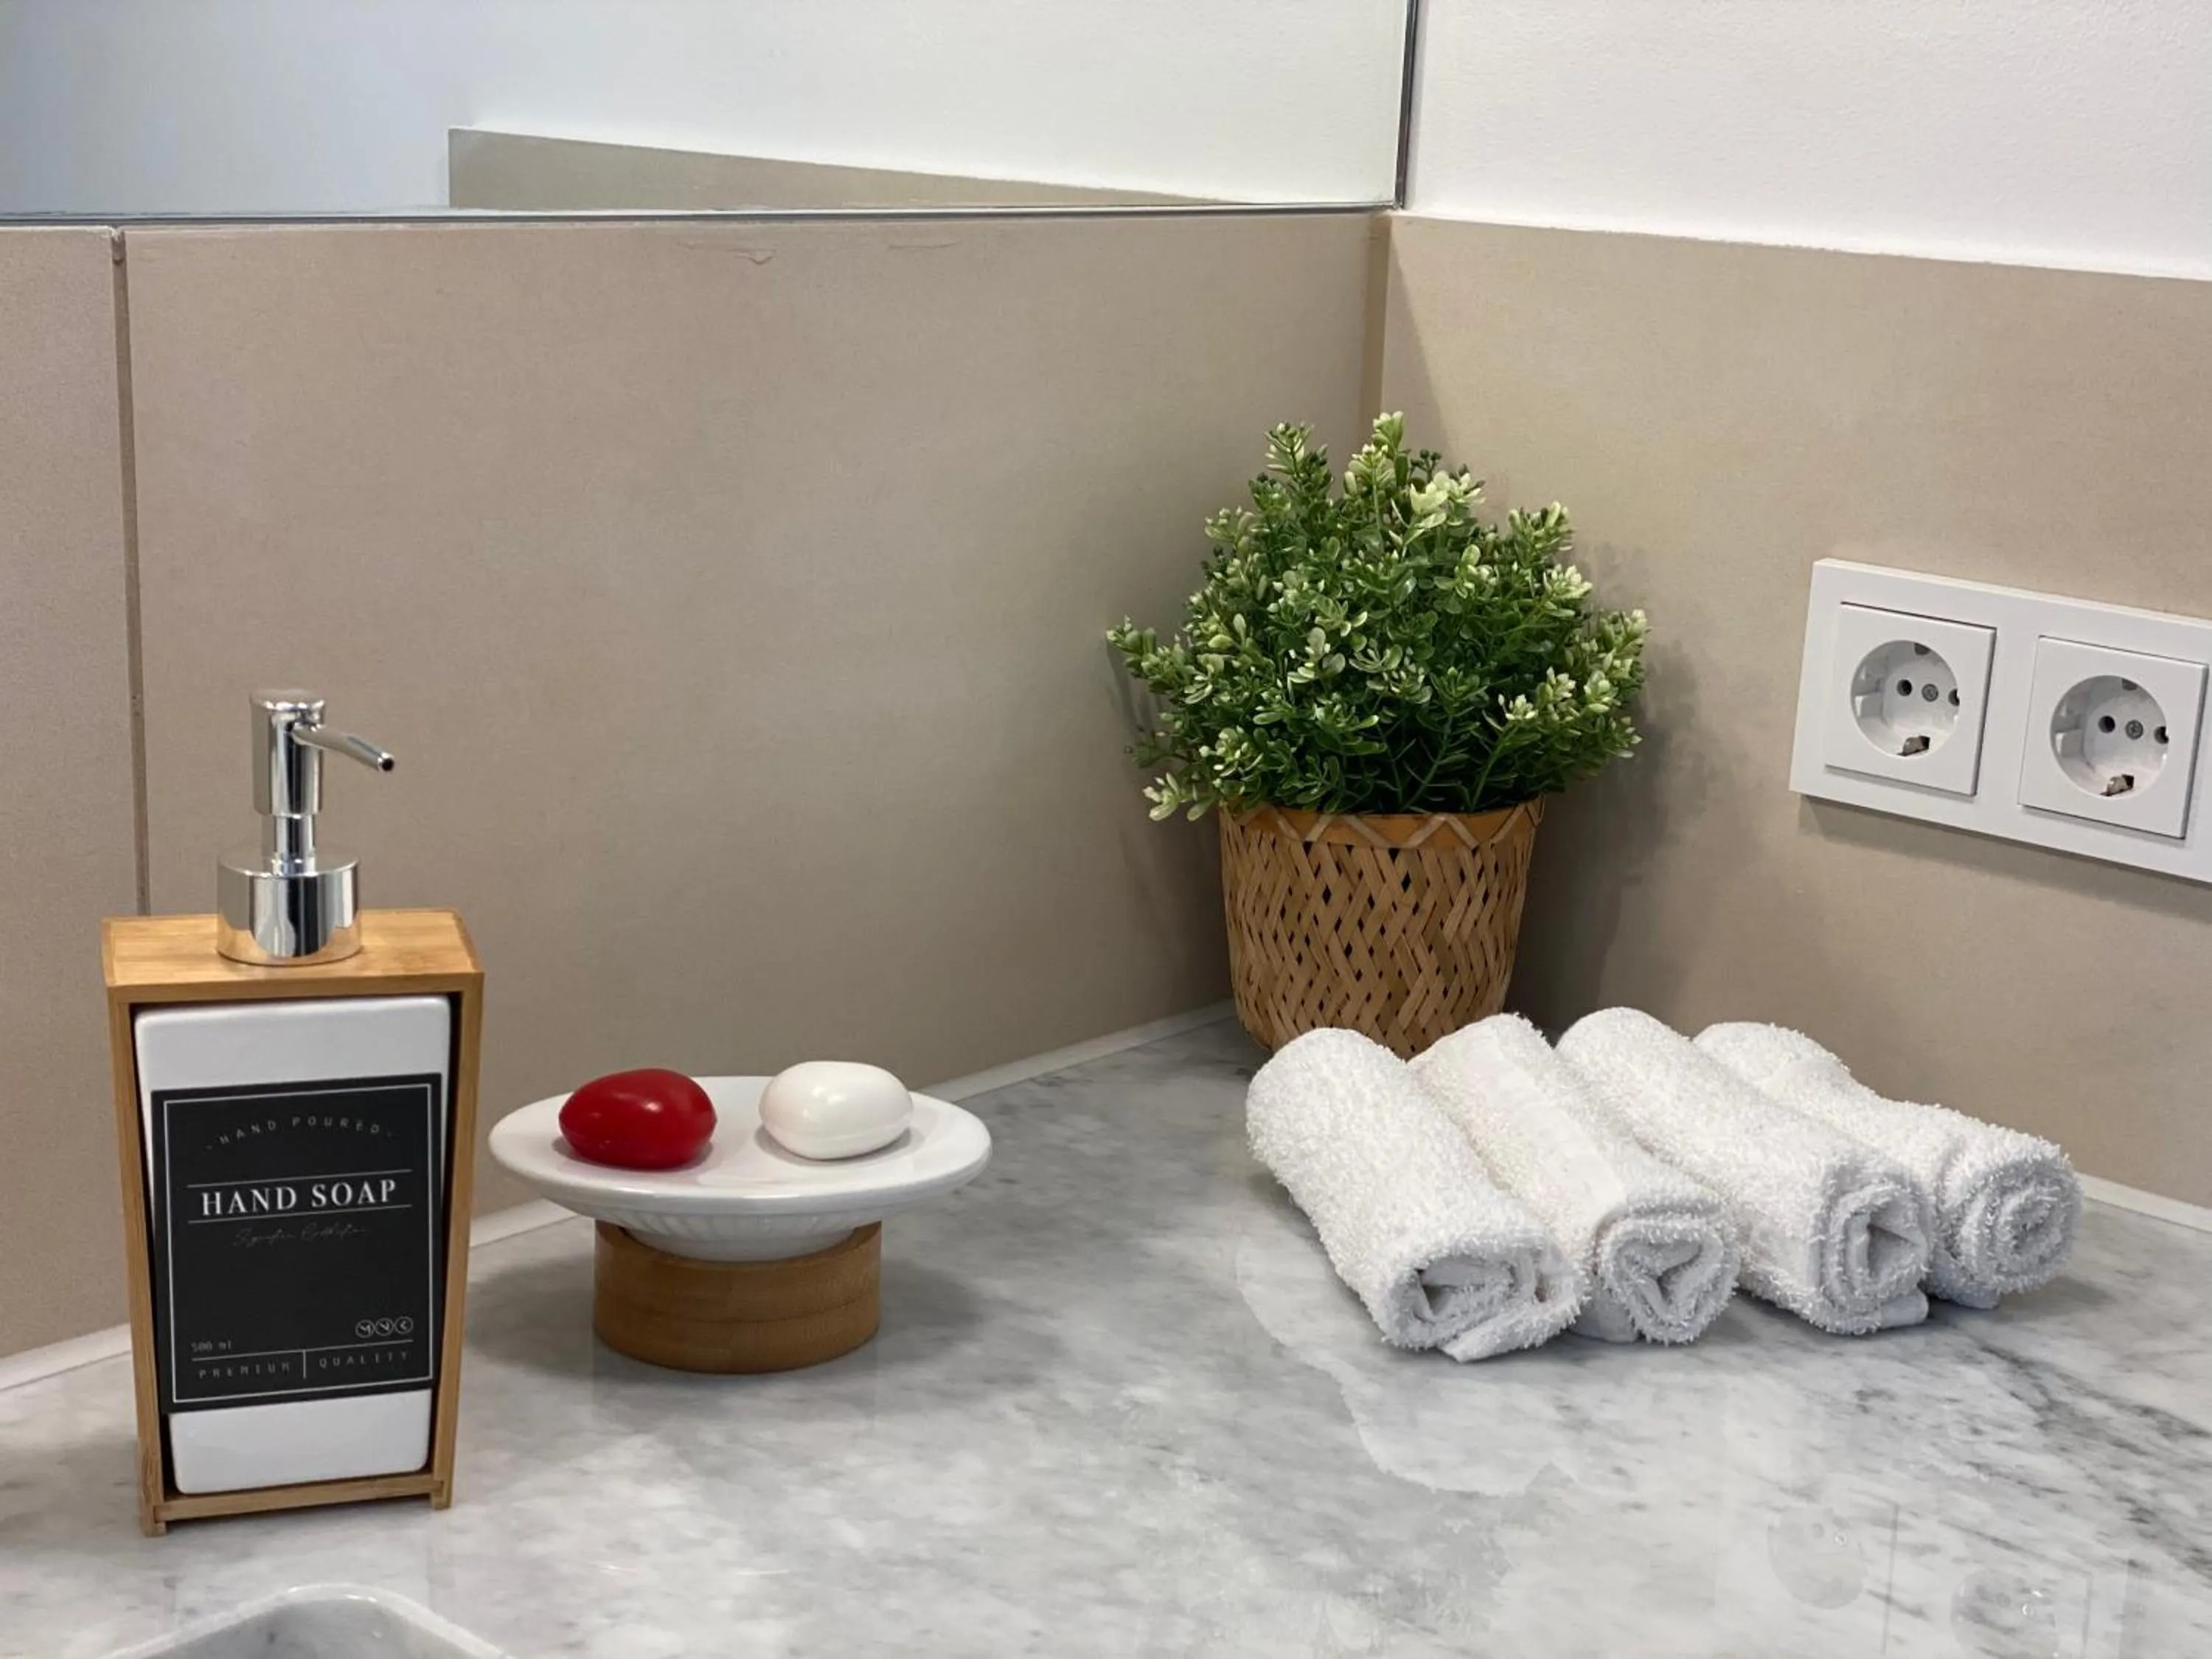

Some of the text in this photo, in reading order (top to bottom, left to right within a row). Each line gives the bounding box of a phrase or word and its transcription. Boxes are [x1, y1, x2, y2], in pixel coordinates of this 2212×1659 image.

[218, 1116, 380, 1145] HAND POURED
[201, 1179, 397, 1217] HAND SOAP
[198, 1350, 408, 1380] PREMIUM QUALITY
